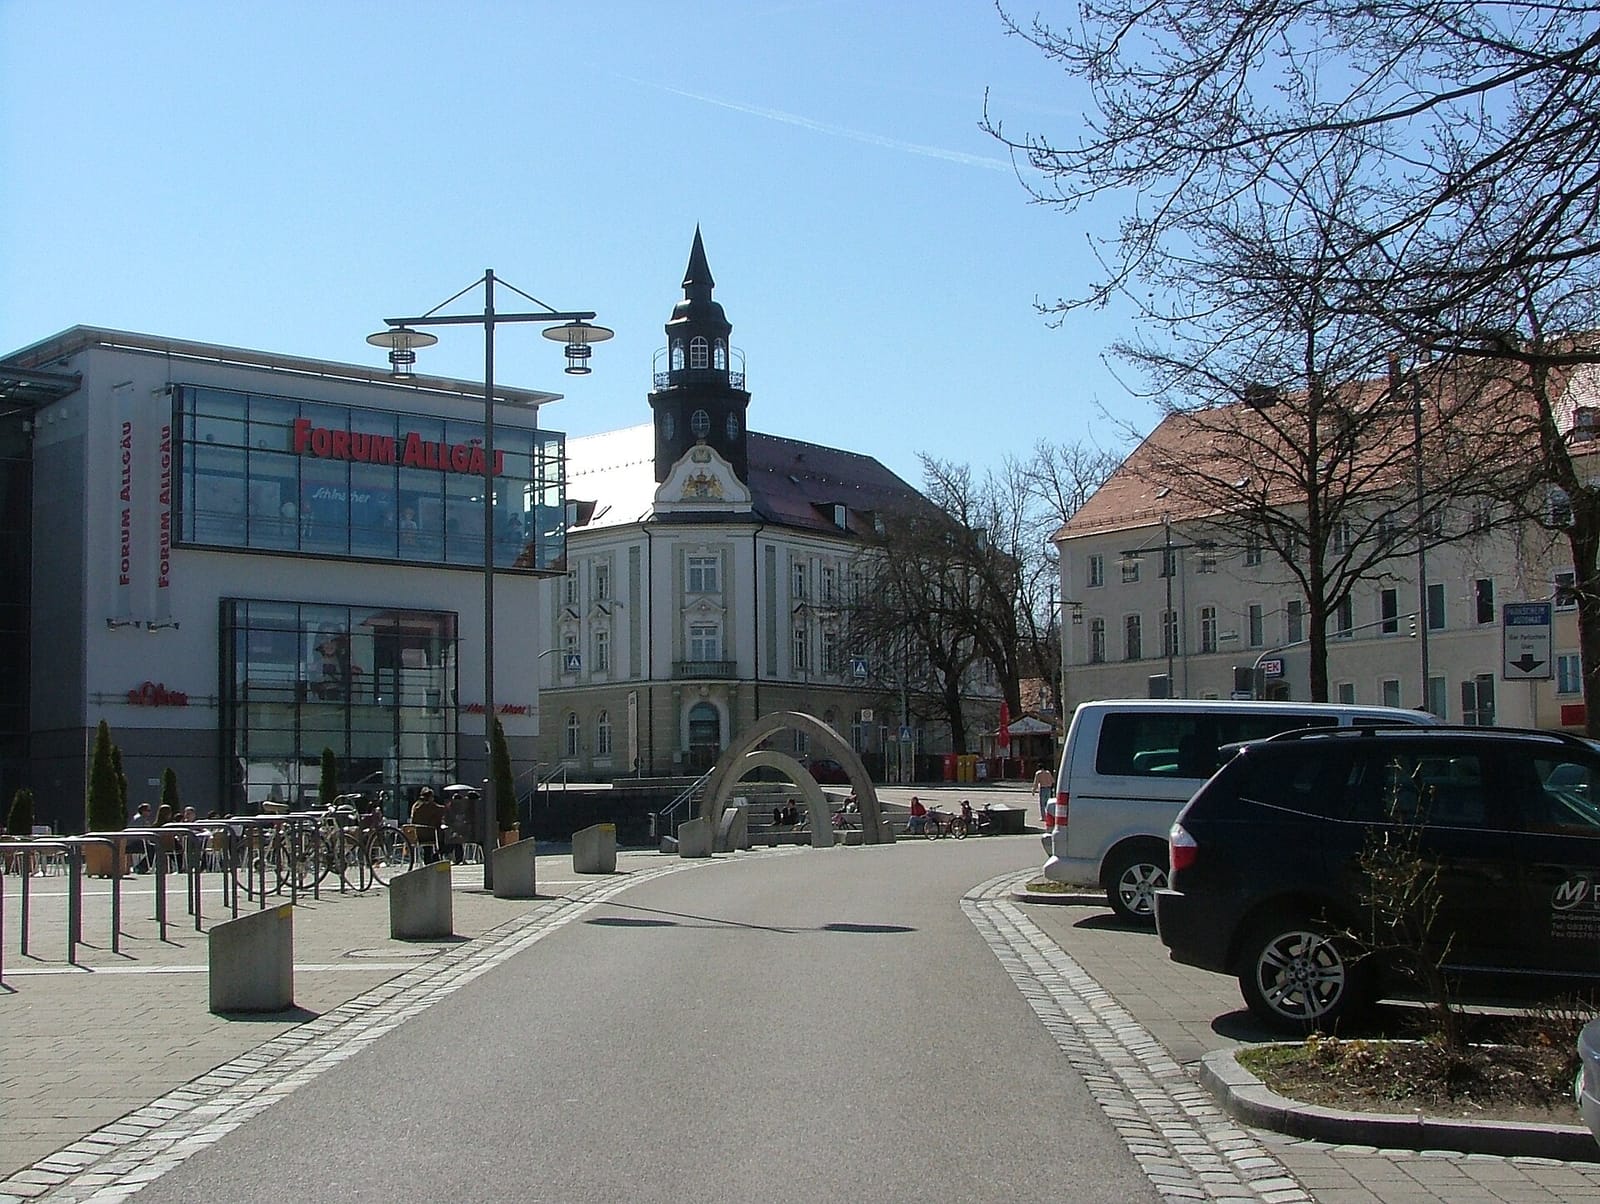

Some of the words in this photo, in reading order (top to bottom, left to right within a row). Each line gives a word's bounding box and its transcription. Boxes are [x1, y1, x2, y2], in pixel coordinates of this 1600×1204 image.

[120, 421, 131, 501] ALLGÄU
[160, 425, 170, 505] ALLGÄU
[293, 416, 396, 465] FORUM
[403, 431, 504, 476] ALLGÄU
[120, 508, 130, 586] FORUM
[159, 511, 170, 588] FORUM
